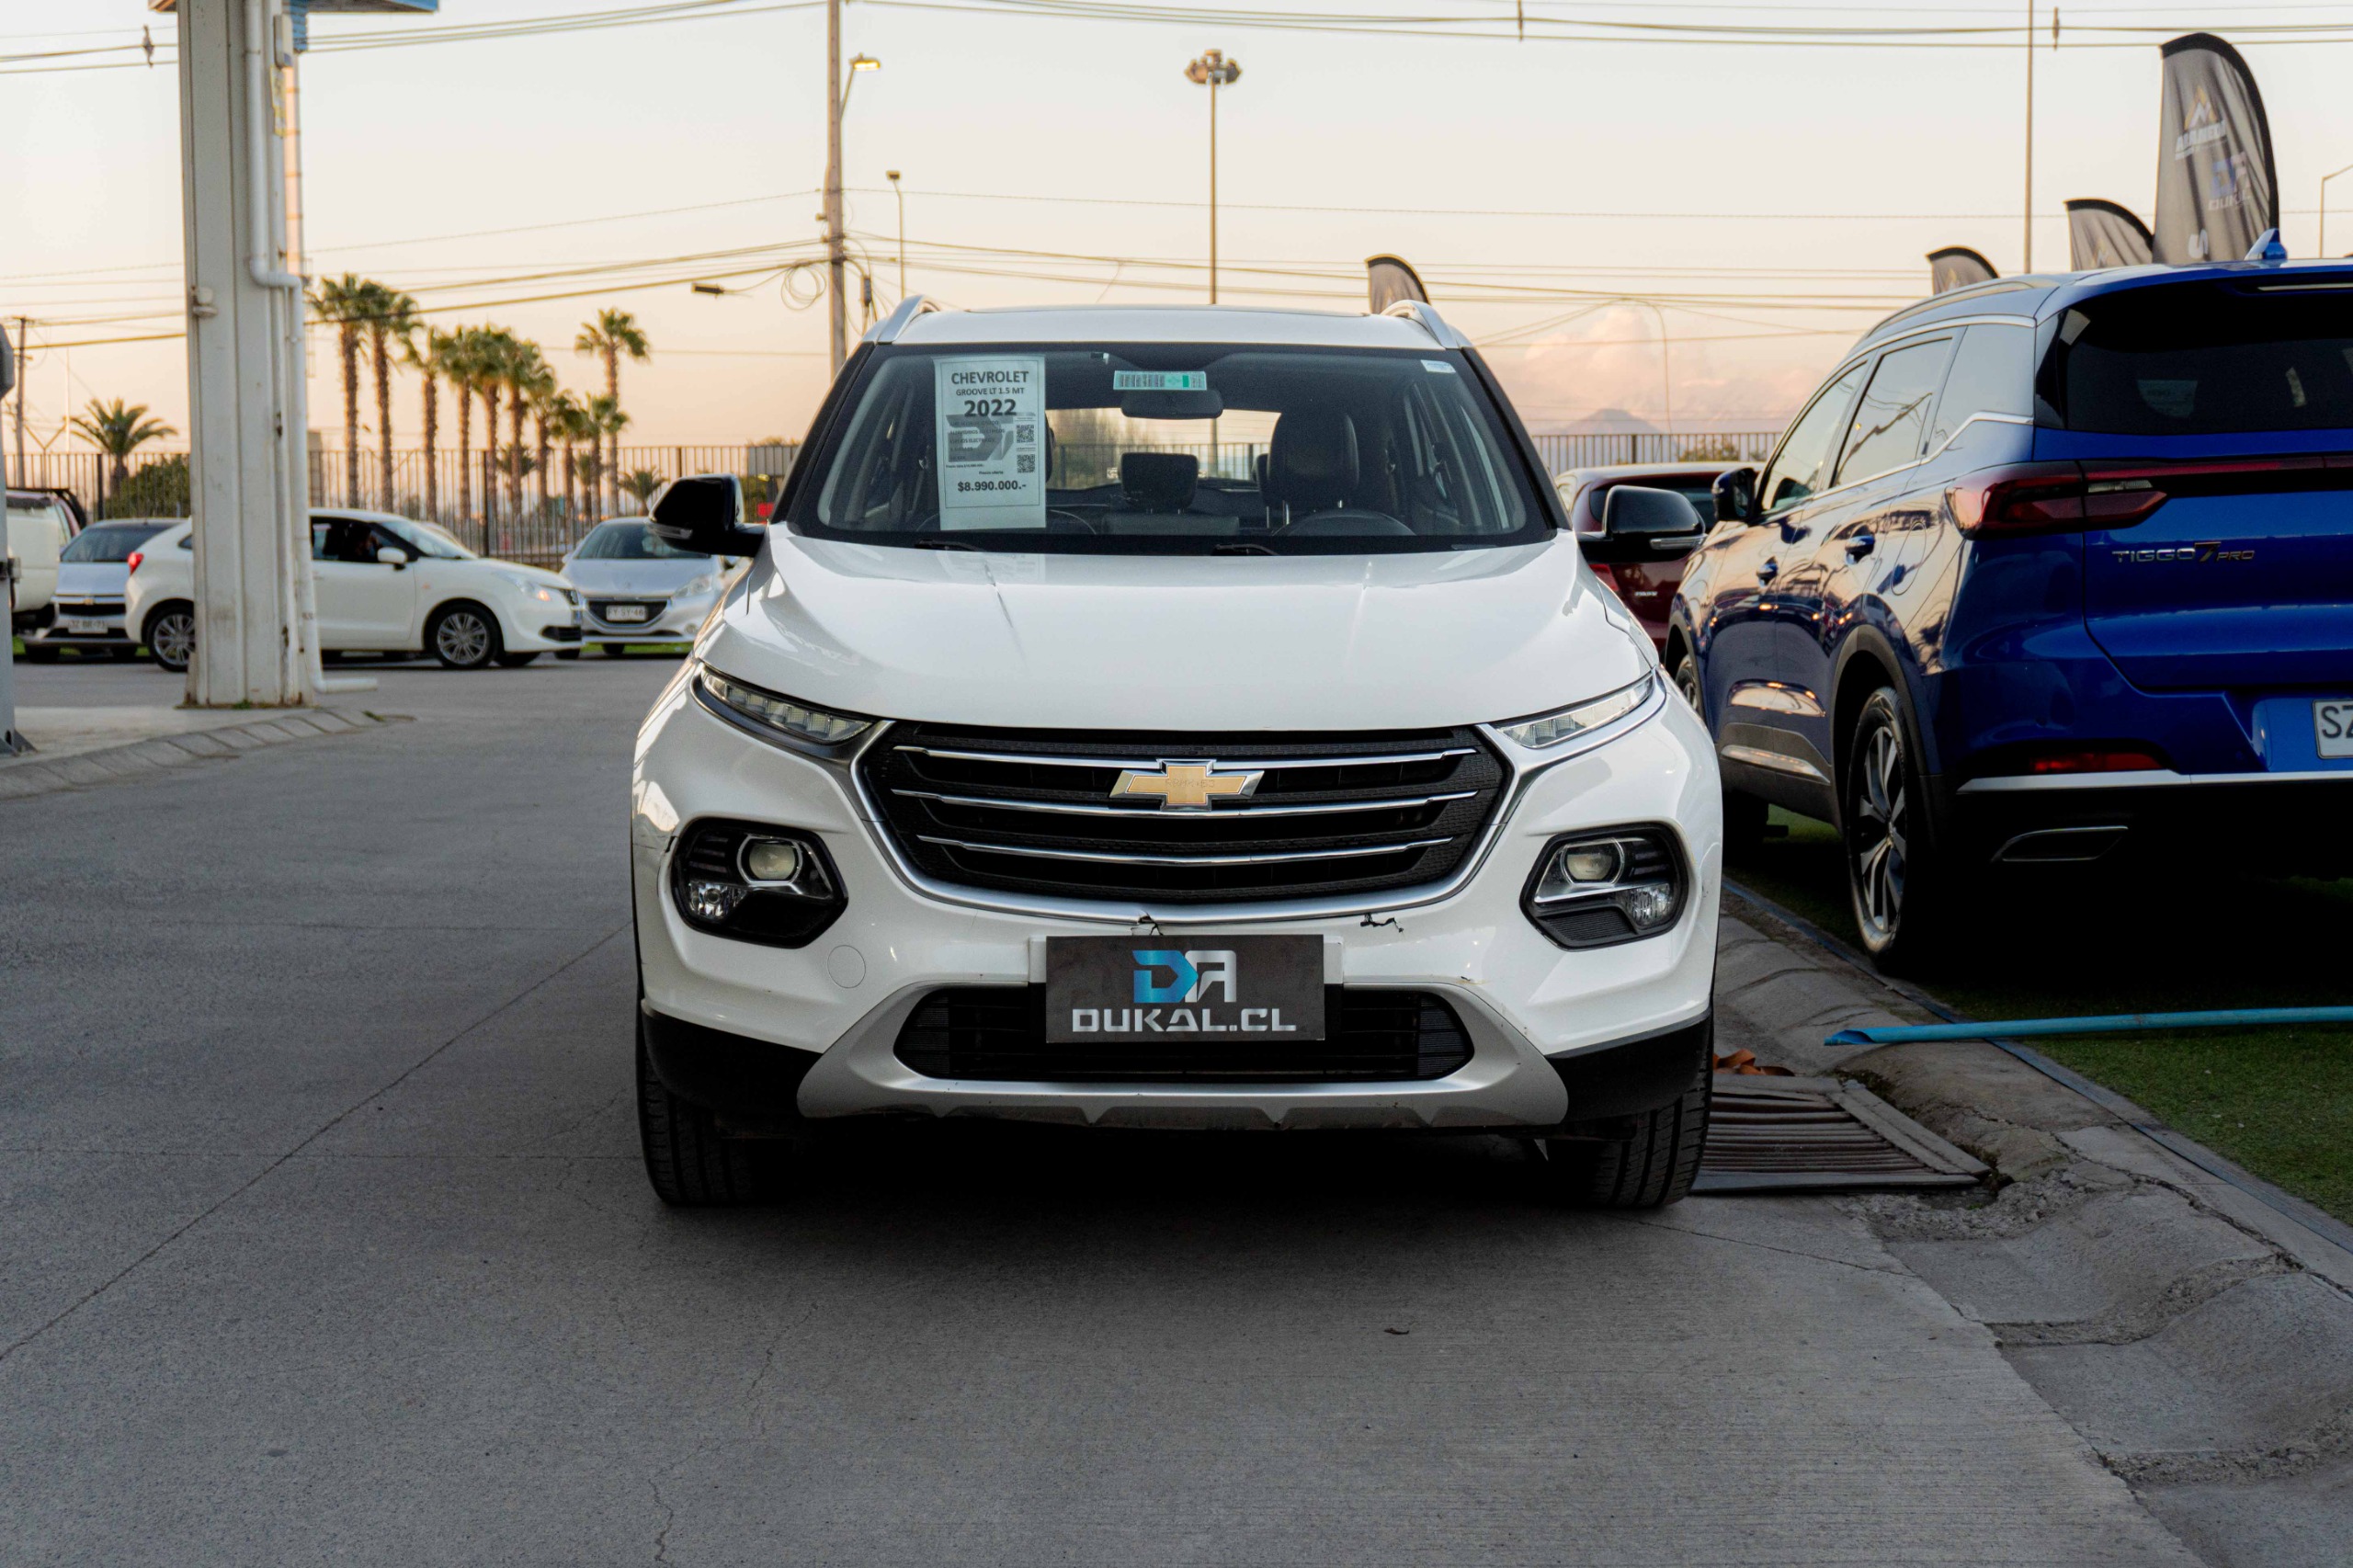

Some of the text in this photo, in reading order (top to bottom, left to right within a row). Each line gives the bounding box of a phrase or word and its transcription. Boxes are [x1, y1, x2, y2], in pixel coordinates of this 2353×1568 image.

[951, 370, 1029, 384] CHEVROLET
[956, 388, 987, 396] GROOVE
[964, 398, 1017, 417] 2022
[958, 480, 1027, 493] $8.990.000.-
[2111, 540, 2256, 562] TIGGO 7 PRO
[1072, 1008, 1297, 1032] DUKAL.CL
